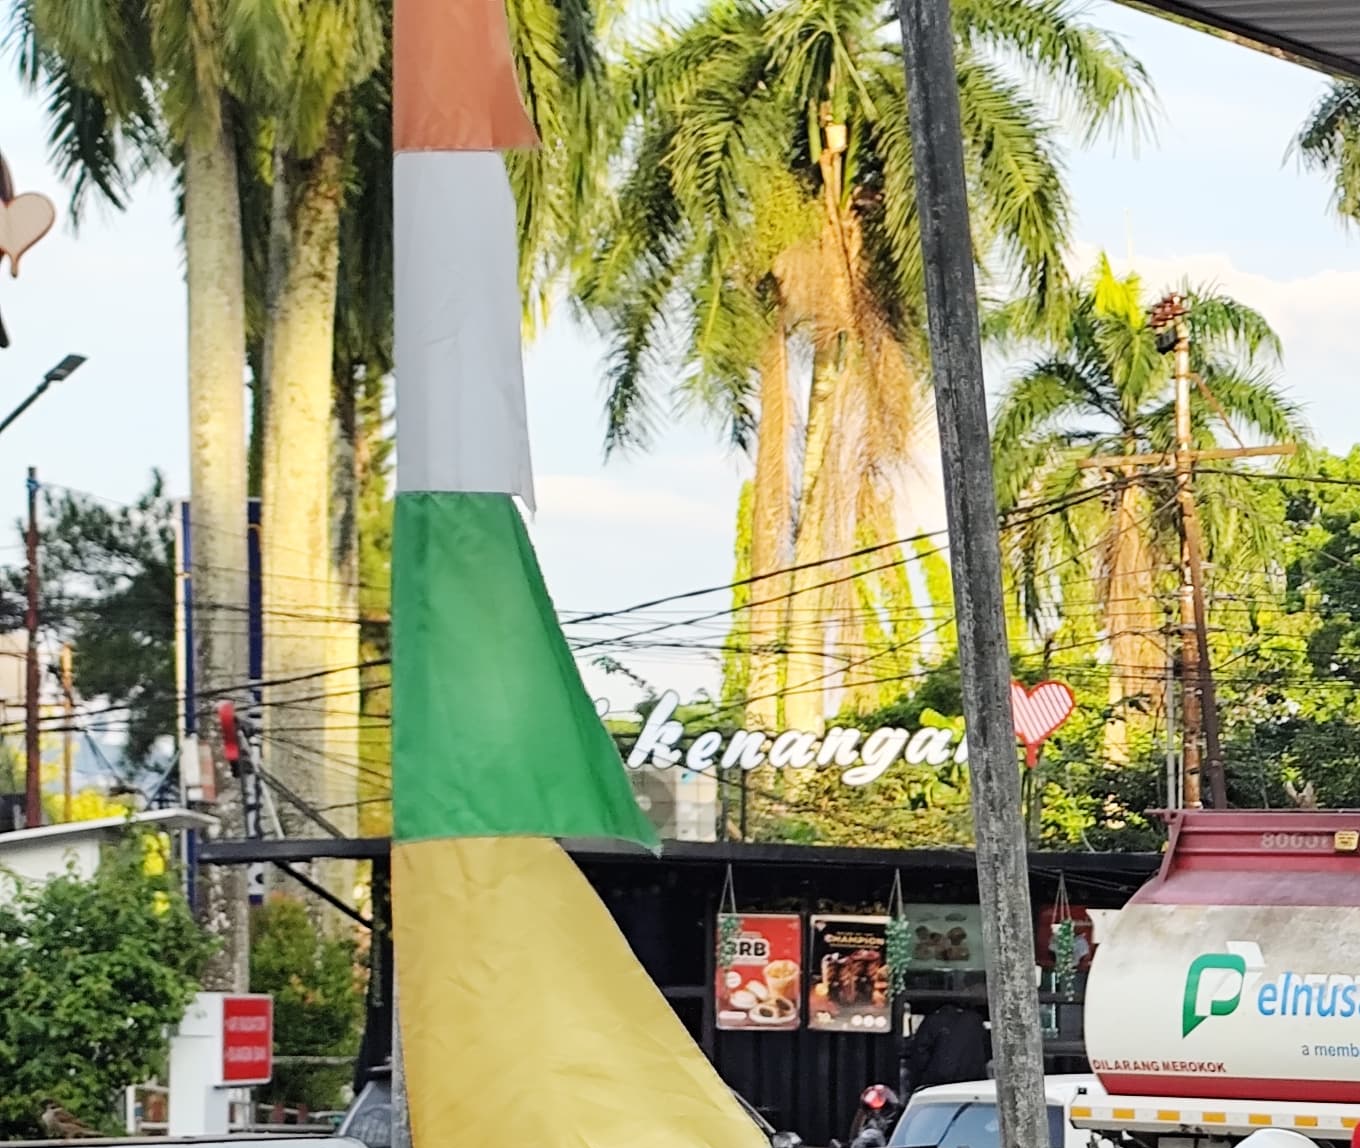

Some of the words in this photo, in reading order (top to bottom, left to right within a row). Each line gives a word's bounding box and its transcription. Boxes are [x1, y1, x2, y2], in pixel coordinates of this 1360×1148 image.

[627, 688, 970, 786] kenanga
[1302, 1044, 1310, 1056] a
[1093, 1059, 1159, 1073] DILARANG
[1162, 1061, 1226, 1074] MEROKOK
